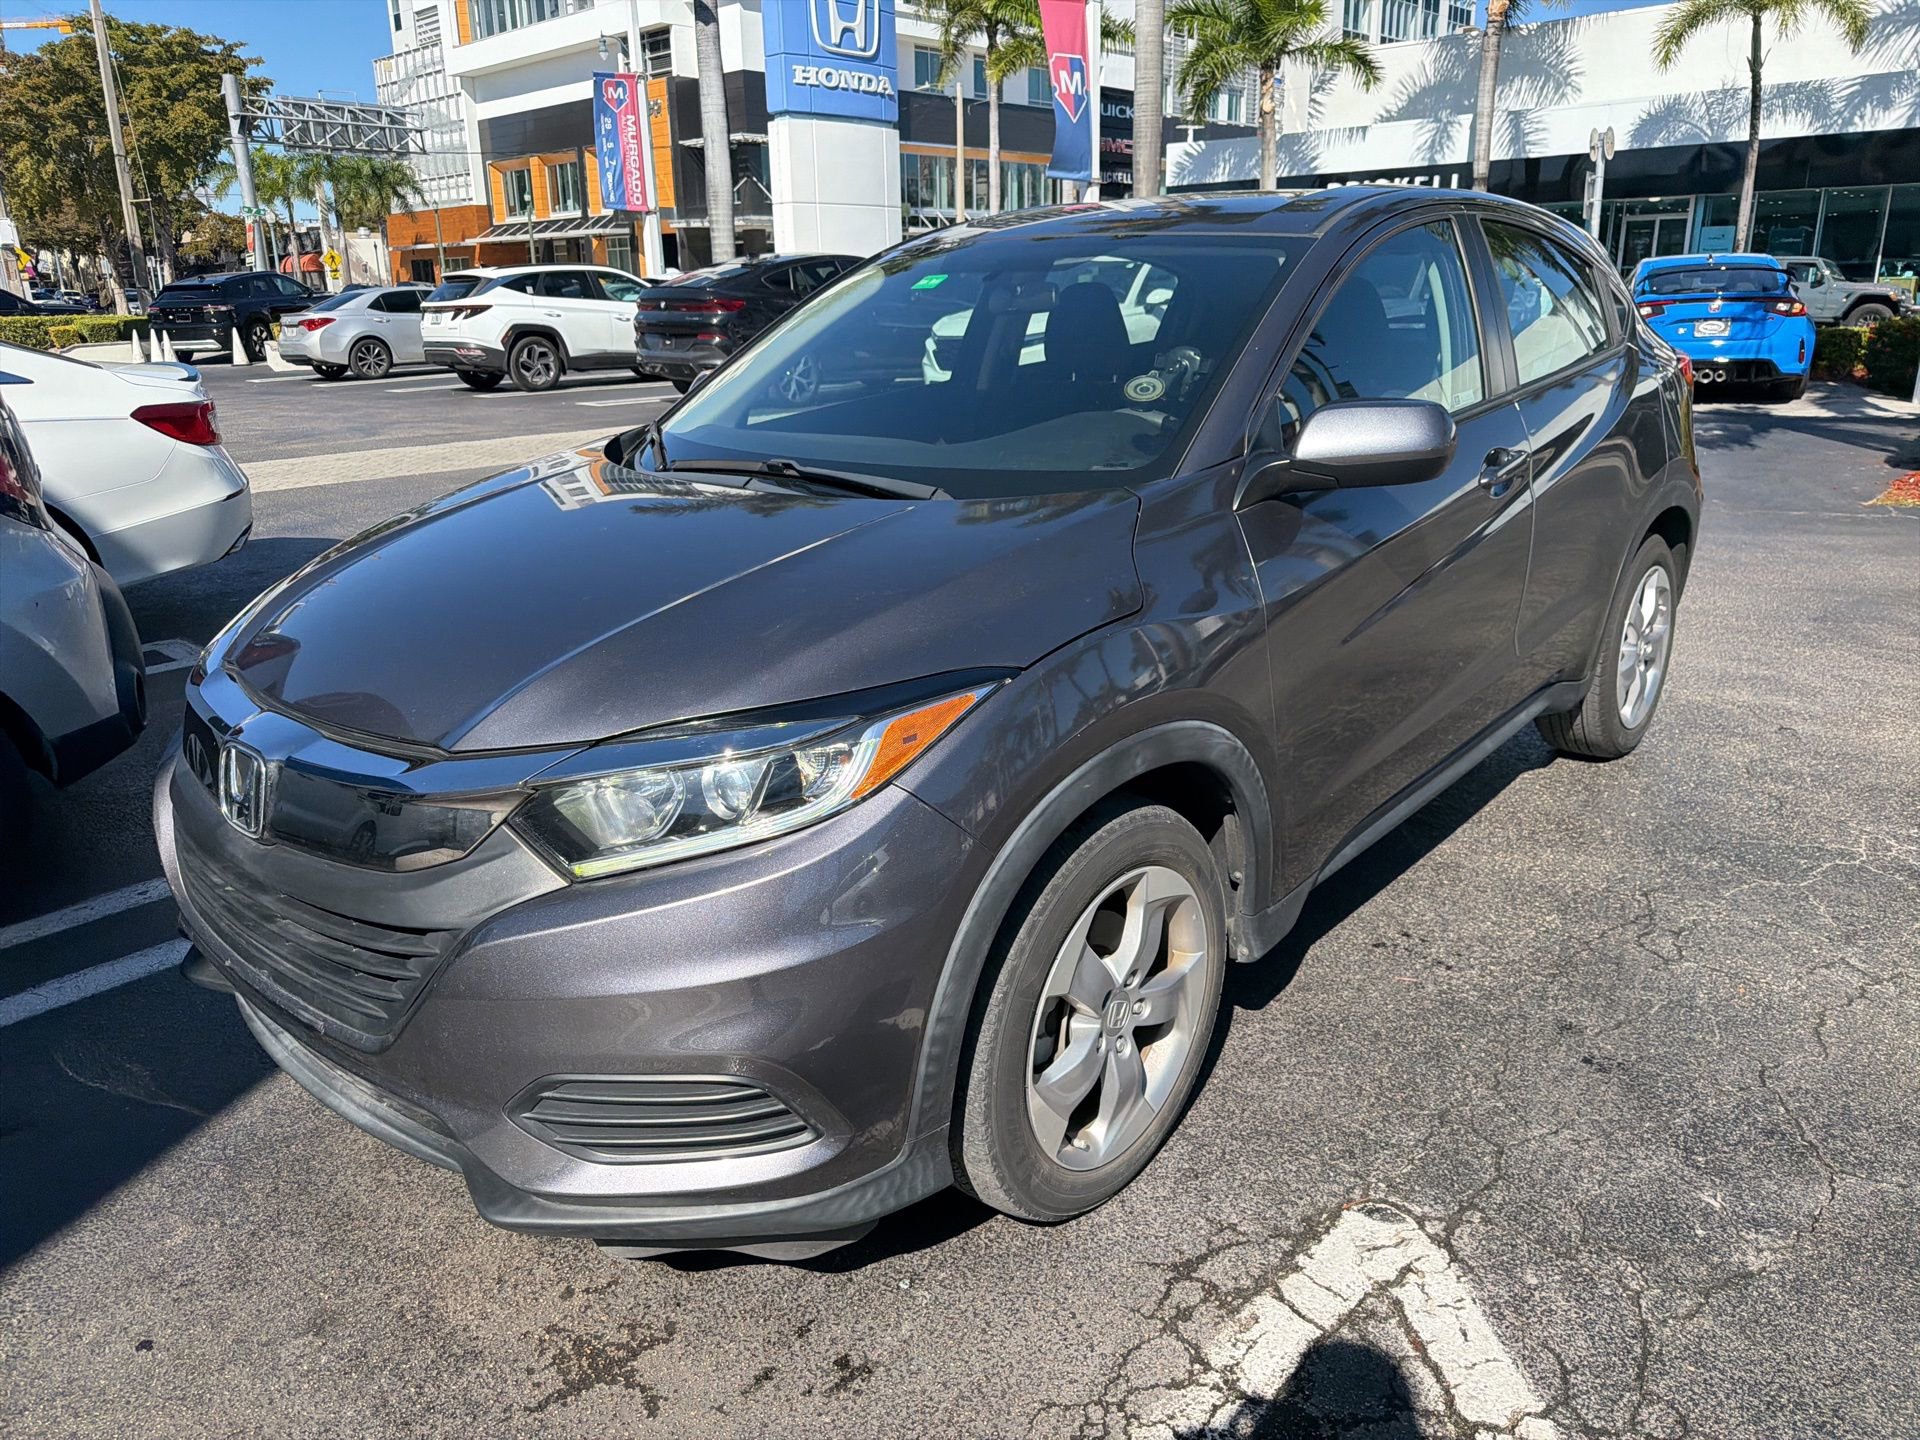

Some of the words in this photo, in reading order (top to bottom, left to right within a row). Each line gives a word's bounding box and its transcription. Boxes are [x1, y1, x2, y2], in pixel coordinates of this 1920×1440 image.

[792, 65, 894, 95] HONDA
[1059, 70, 1082, 95] M
[607, 87, 624, 99] M
[1101, 103, 1135, 119] UICK
[605, 117, 612, 129] 29
[1100, 137, 1135, 155] MC
[627, 115, 642, 205] MURGADO
[1101, 171, 1133, 184] ICKELL
